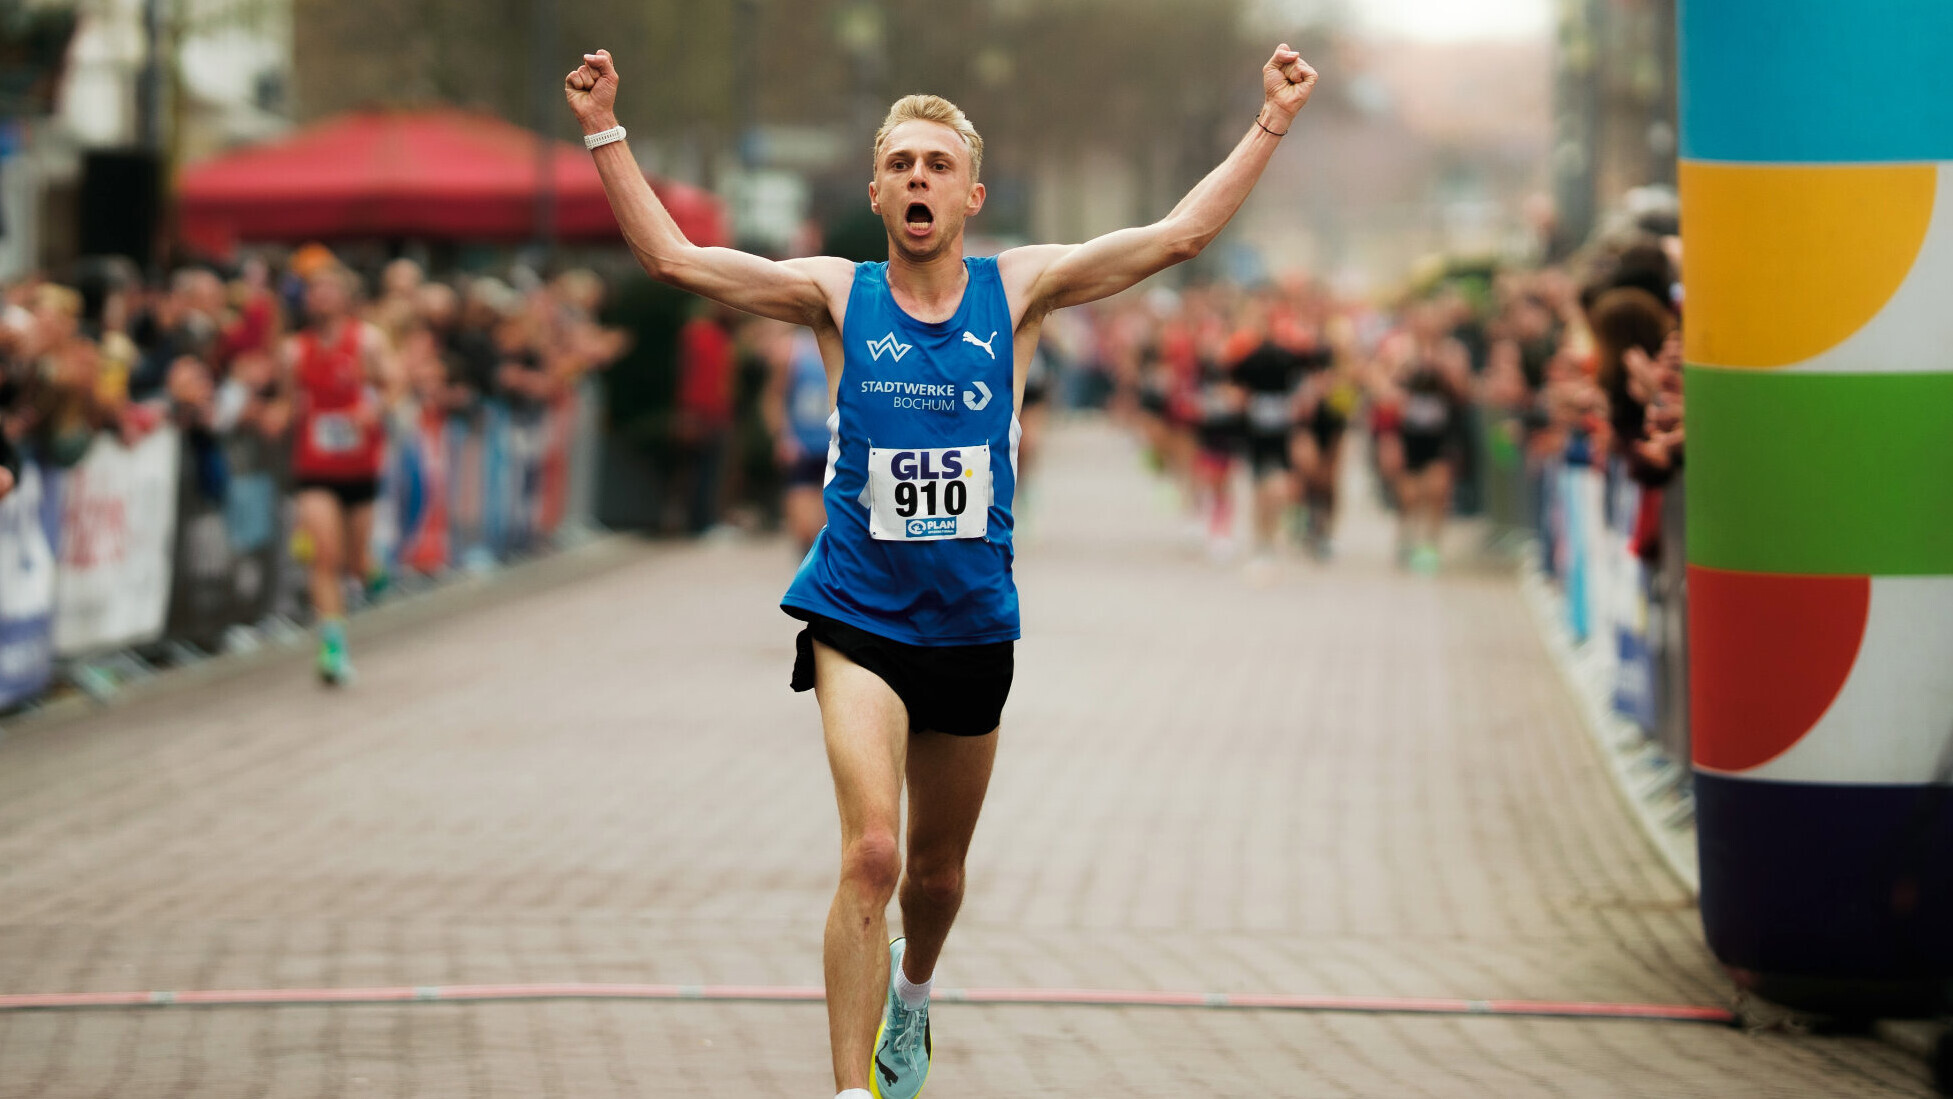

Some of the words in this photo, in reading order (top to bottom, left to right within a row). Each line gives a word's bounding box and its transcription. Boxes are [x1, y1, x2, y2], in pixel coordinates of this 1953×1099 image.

[861, 381, 955, 396] STADTWERKE
[893, 396, 955, 411] BOCHUM
[894, 480, 967, 518] 910
[927, 520, 955, 530] PLAN
